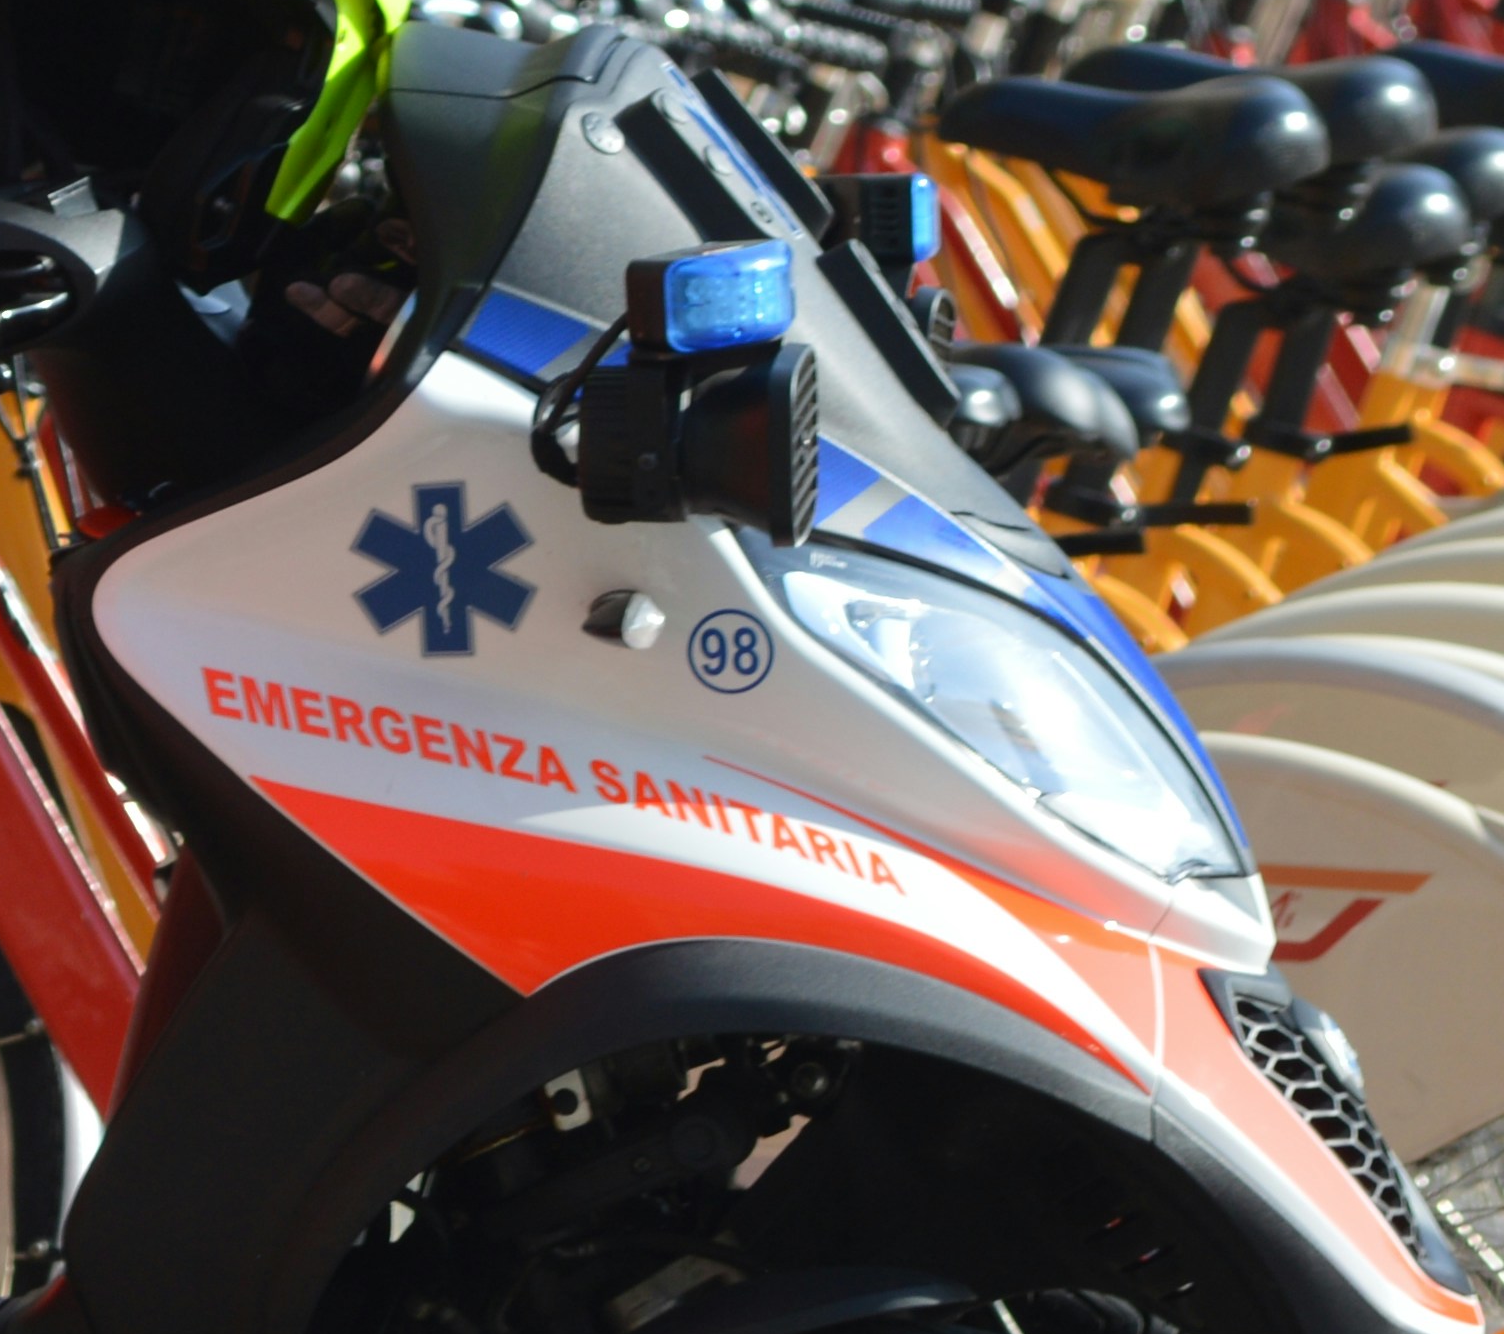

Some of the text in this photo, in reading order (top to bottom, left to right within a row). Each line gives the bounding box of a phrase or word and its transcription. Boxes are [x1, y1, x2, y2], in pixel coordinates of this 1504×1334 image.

[699, 627, 759, 676] 98
[201, 667, 907, 896] EMERGENZA SANITARIA
